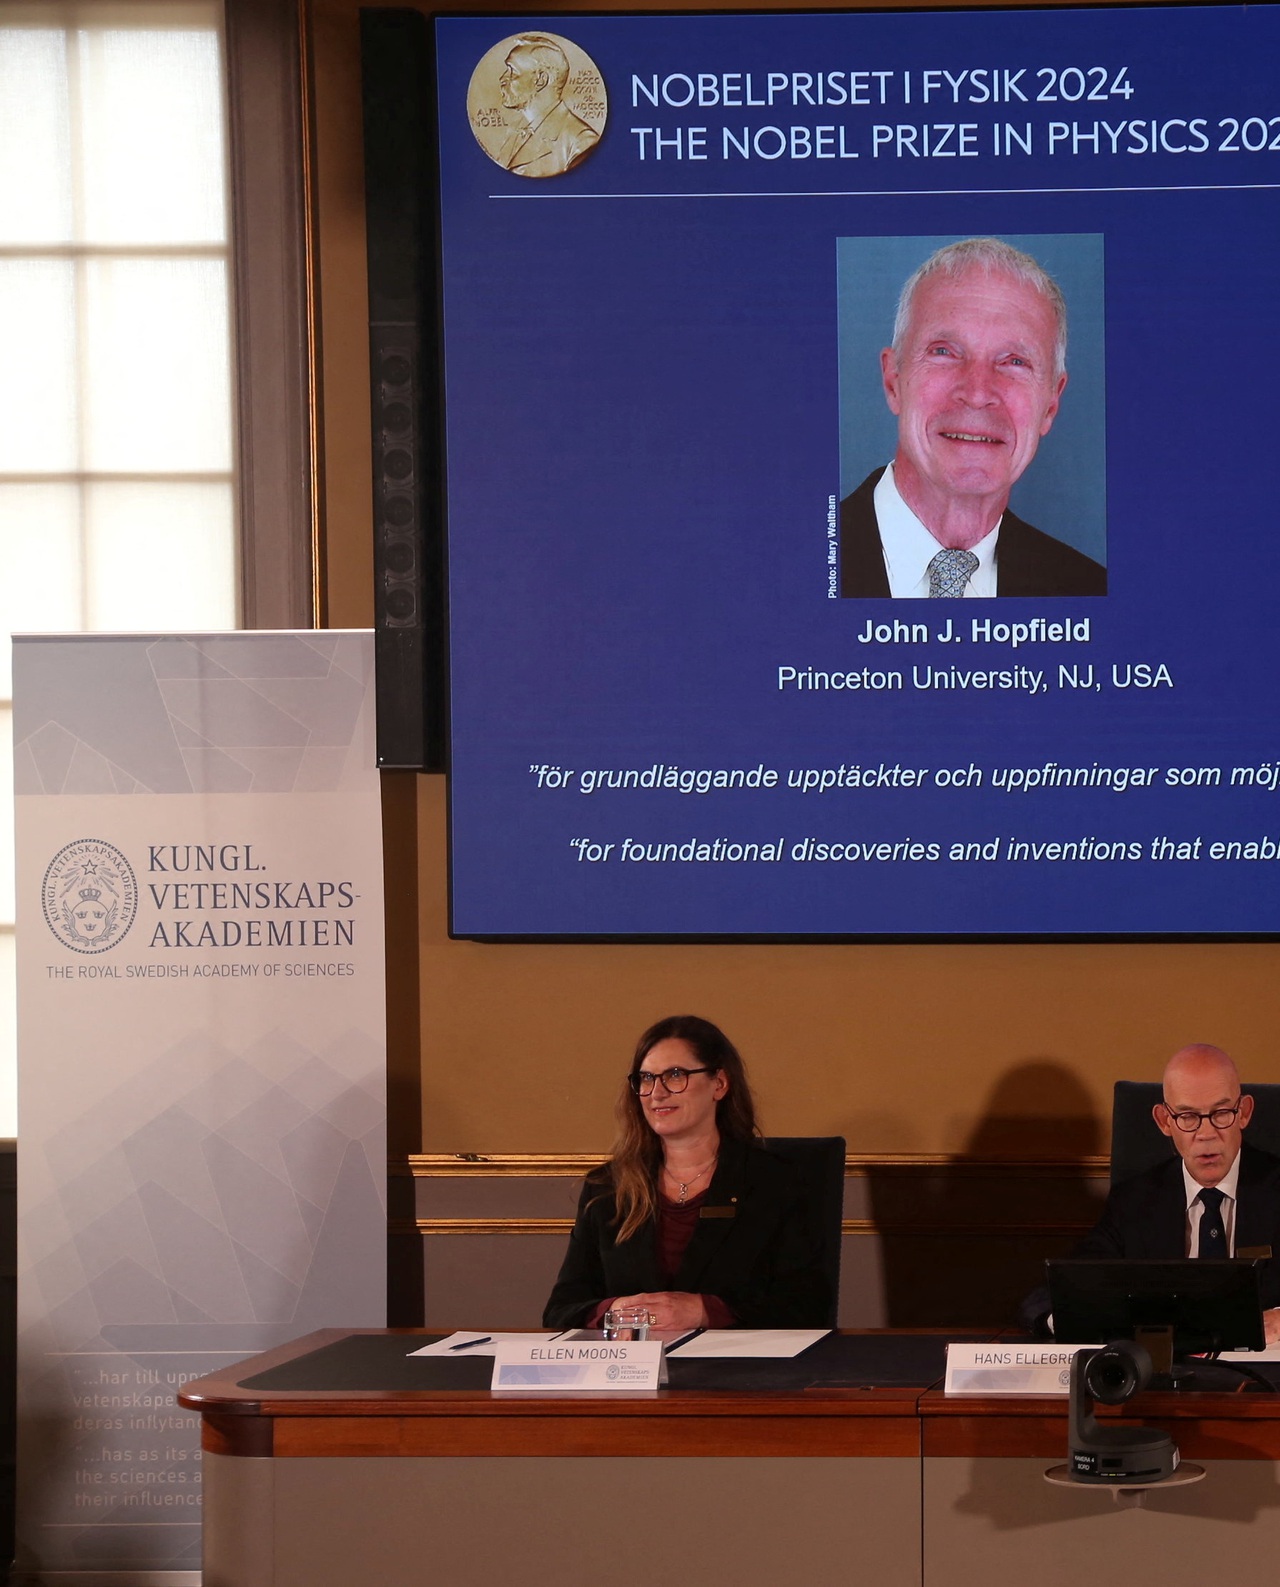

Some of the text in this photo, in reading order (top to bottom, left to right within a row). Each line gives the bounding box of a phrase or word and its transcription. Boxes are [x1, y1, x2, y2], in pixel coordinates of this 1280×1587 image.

[632, 67, 1134, 107] NOBELPRISET I FYSIK 2024
[631, 128, 707, 160] THE
[723, 126, 858, 159] NOBEL
[873, 124, 978, 157] PRIZE
[994, 123, 1031, 155] IN
[1049, 119, 1209, 154] PHYSICS
[827, 495, 838, 599] Photo: Mary Waltham
[858, 618, 1089, 647] John J. Hopfield
[779, 664, 1173, 694] Princeton University, NJ, USA
[580, 764, 778, 793] grundläggande
[788, 764, 928, 792] upptäckter
[935, 763, 982, 786] och
[992, 763, 1159, 792] uppfinningar
[1165, 768, 1220, 785] som
[149, 845, 266, 871] KUNGL.
[621, 838, 784, 861] foundational
[792, 838, 940, 860] discoveries
[949, 838, 999, 860] and
[1007, 837, 1142, 860] inventions
[1151, 837, 1202, 859] that
[149, 882, 360, 909] VETENSKAPS-
[150, 920, 355, 947] AKADEMIEN
[46, 963, 354, 978] THE ROYAL SWEDISH ACADEMY OF SCIENCES
[530, 1348, 628, 1360] ELLEN MOONS
[974, 1352, 1074, 1365] HANS ELLEGRE
[135, 1368, 161, 1385] till
[73, 1392, 178, 1410] vetenskape
[72, 1414, 124, 1431] deras
[138, 1449, 160, 1462] as
[165, 1446, 188, 1462] its
[74, 1469, 104, 1485] the
[109, 1468, 186, 1485] sciences
[74, 1491, 118, 1508] their
